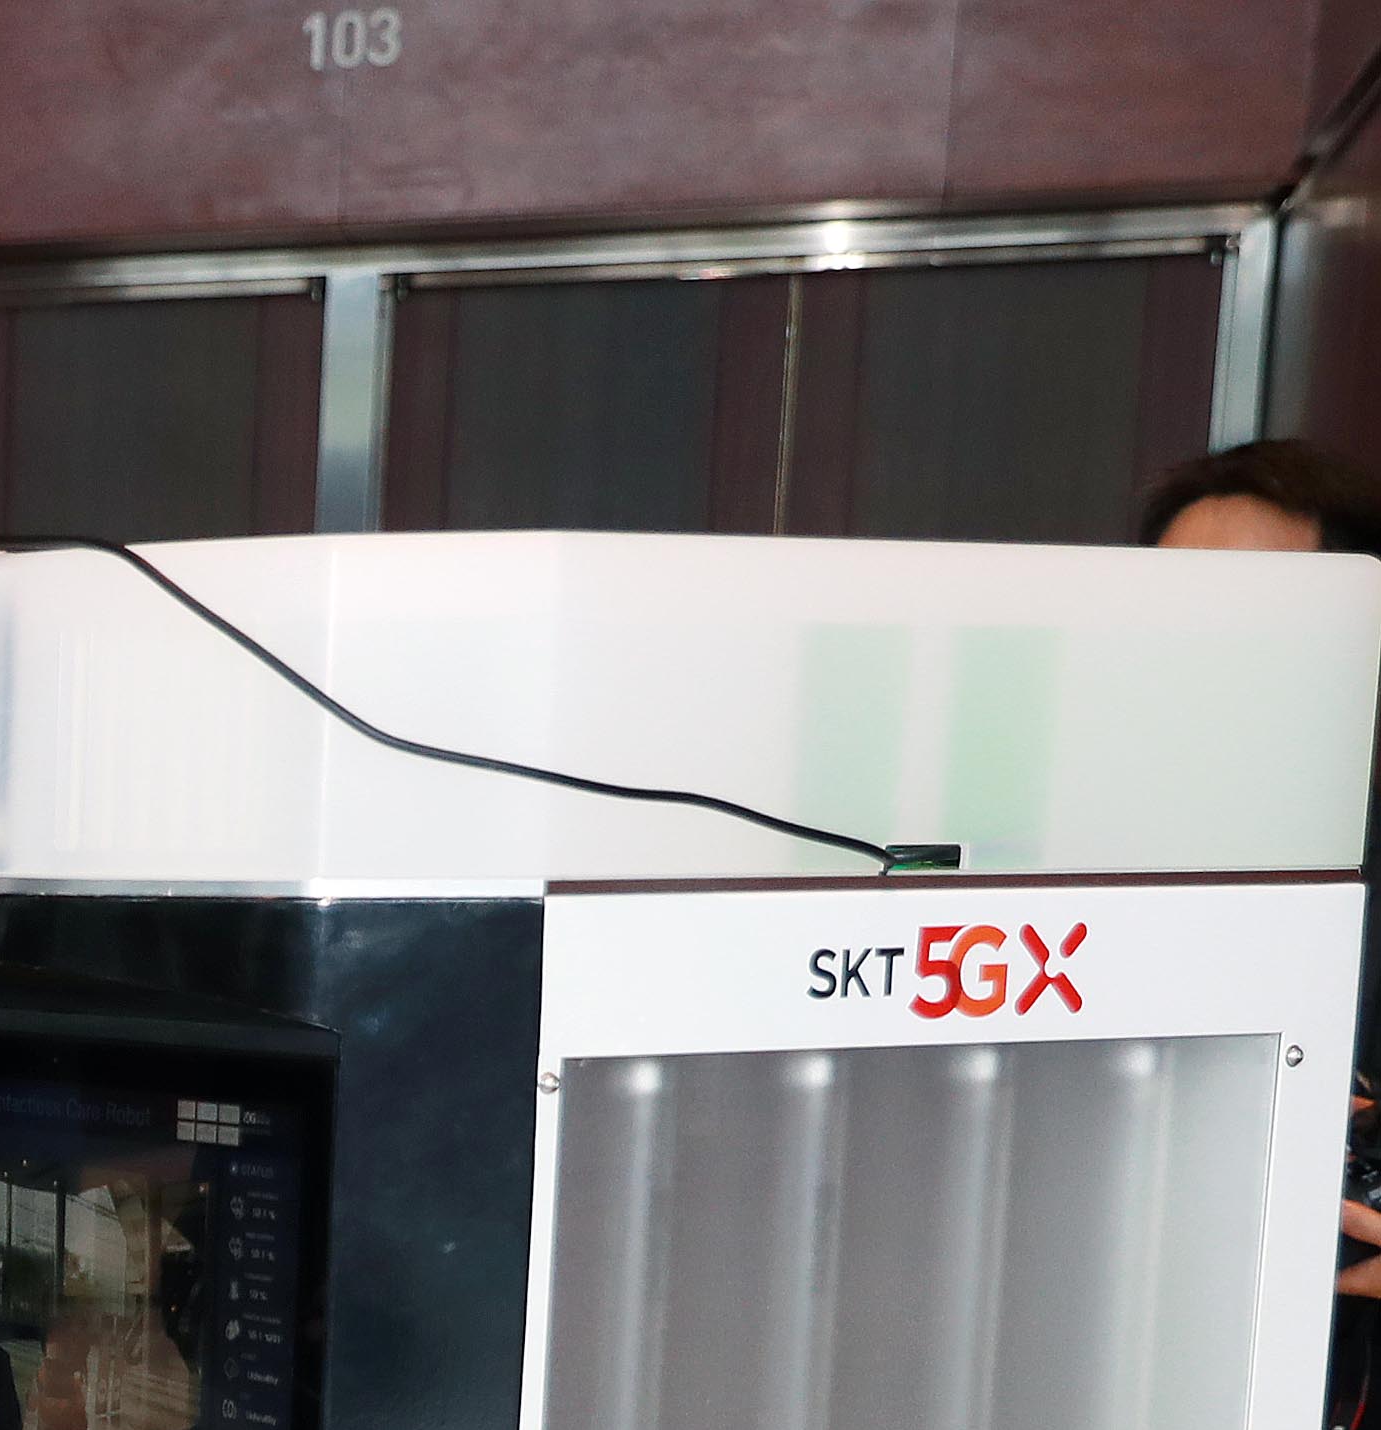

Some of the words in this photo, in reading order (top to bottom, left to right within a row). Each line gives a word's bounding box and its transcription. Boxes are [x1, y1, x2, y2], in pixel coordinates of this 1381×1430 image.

[302, 7, 402, 71] 103
[807, 947, 905, 1000] SKT
[908, 922, 1088, 1019] 5GX
